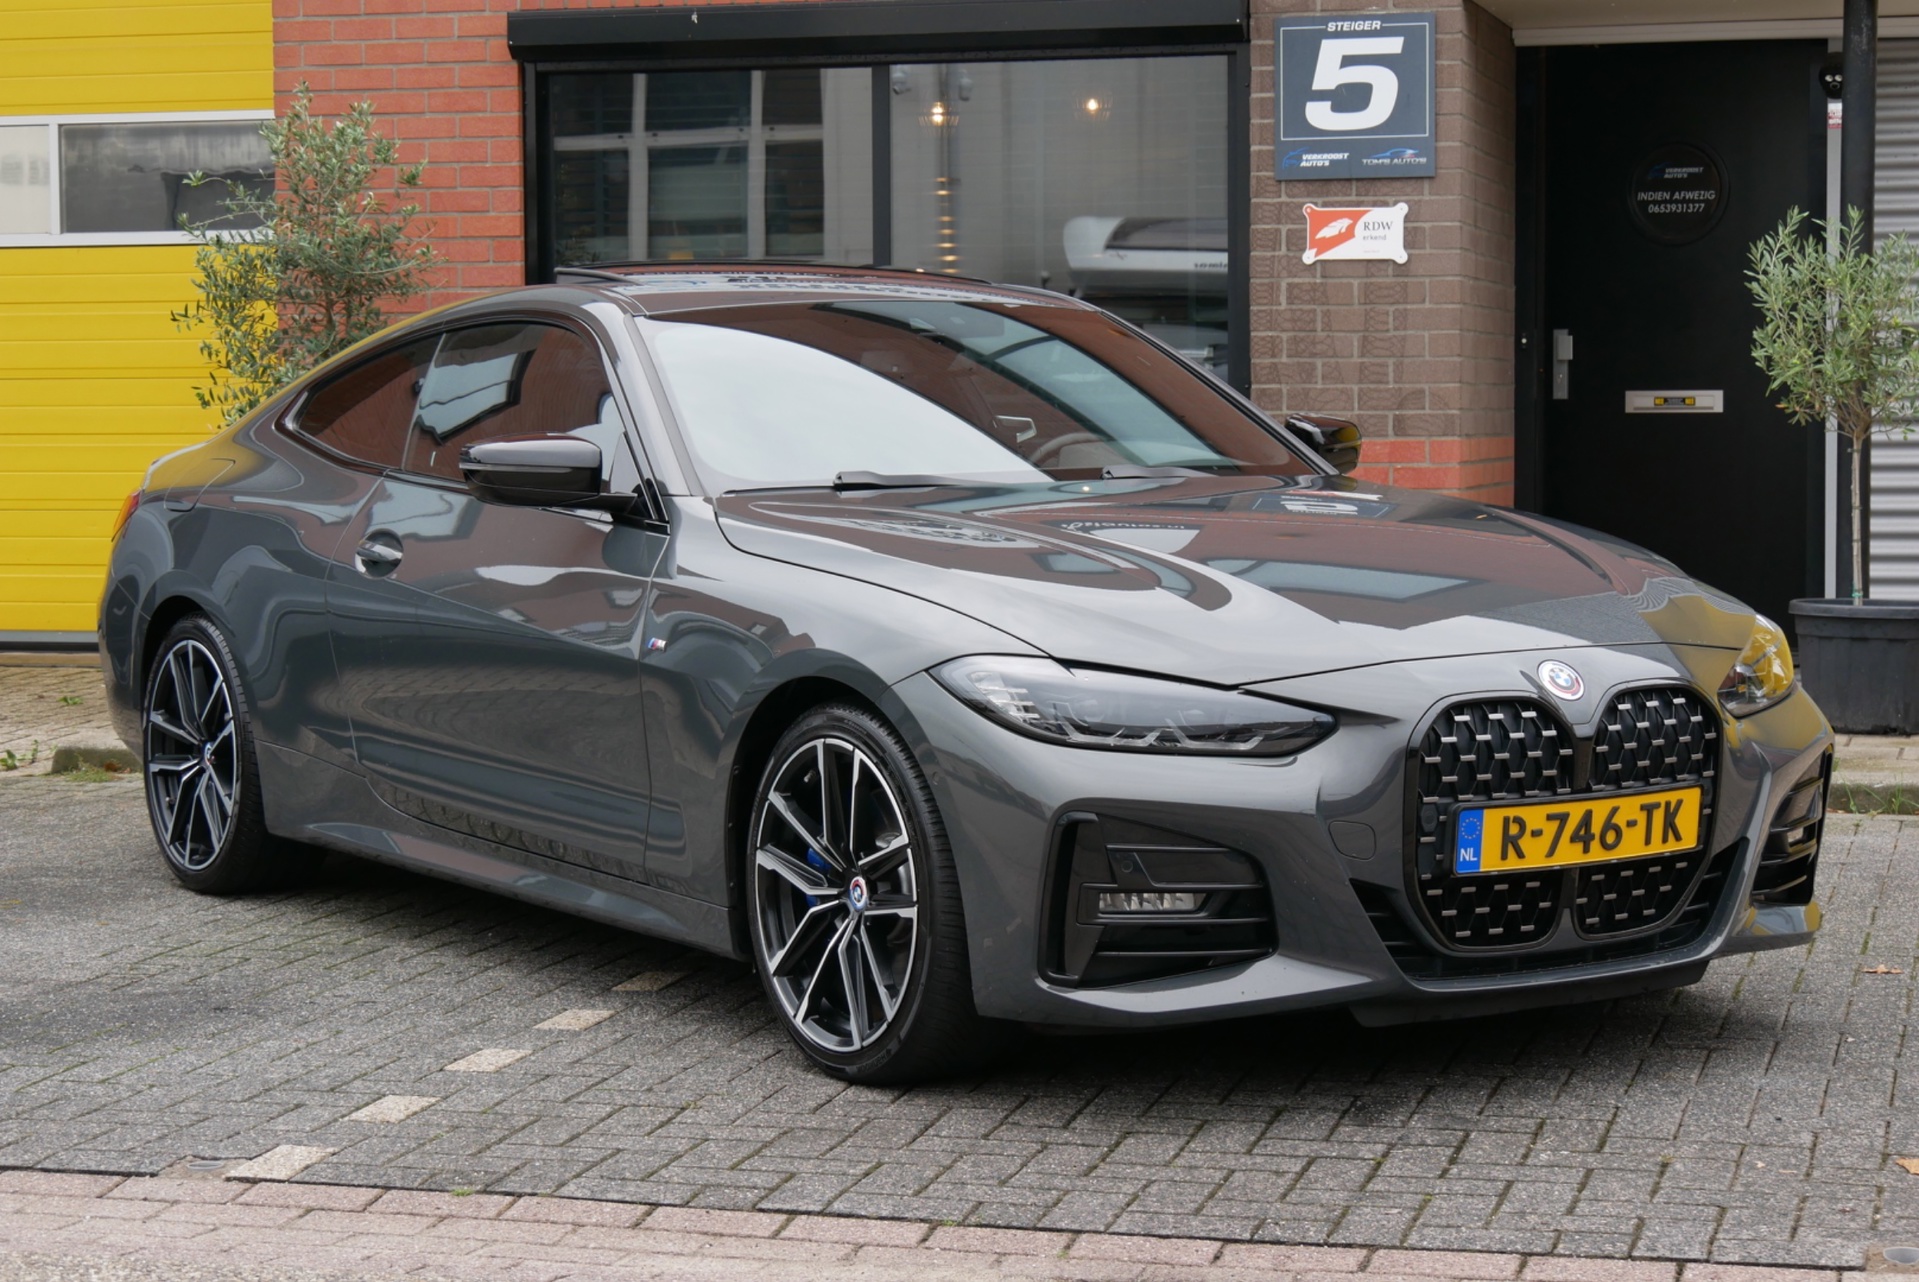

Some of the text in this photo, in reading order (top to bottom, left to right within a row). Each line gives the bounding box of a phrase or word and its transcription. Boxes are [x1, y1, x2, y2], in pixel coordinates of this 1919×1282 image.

[1327, 20, 1382, 32] STEIGER
[1305, 36, 1404, 131] 5
[1302, 152, 1350, 160] VERKROOST
[1637, 190, 1716, 201] INDIEN AFWEZIG
[1647, 203, 1705, 213] 0653931377
[1363, 221, 1393, 232] RDW
[1362, 233, 1387, 241] erkend
[1500, 798, 1684, 862] R-746-TK
[1460, 847, 1478, 862] NL
